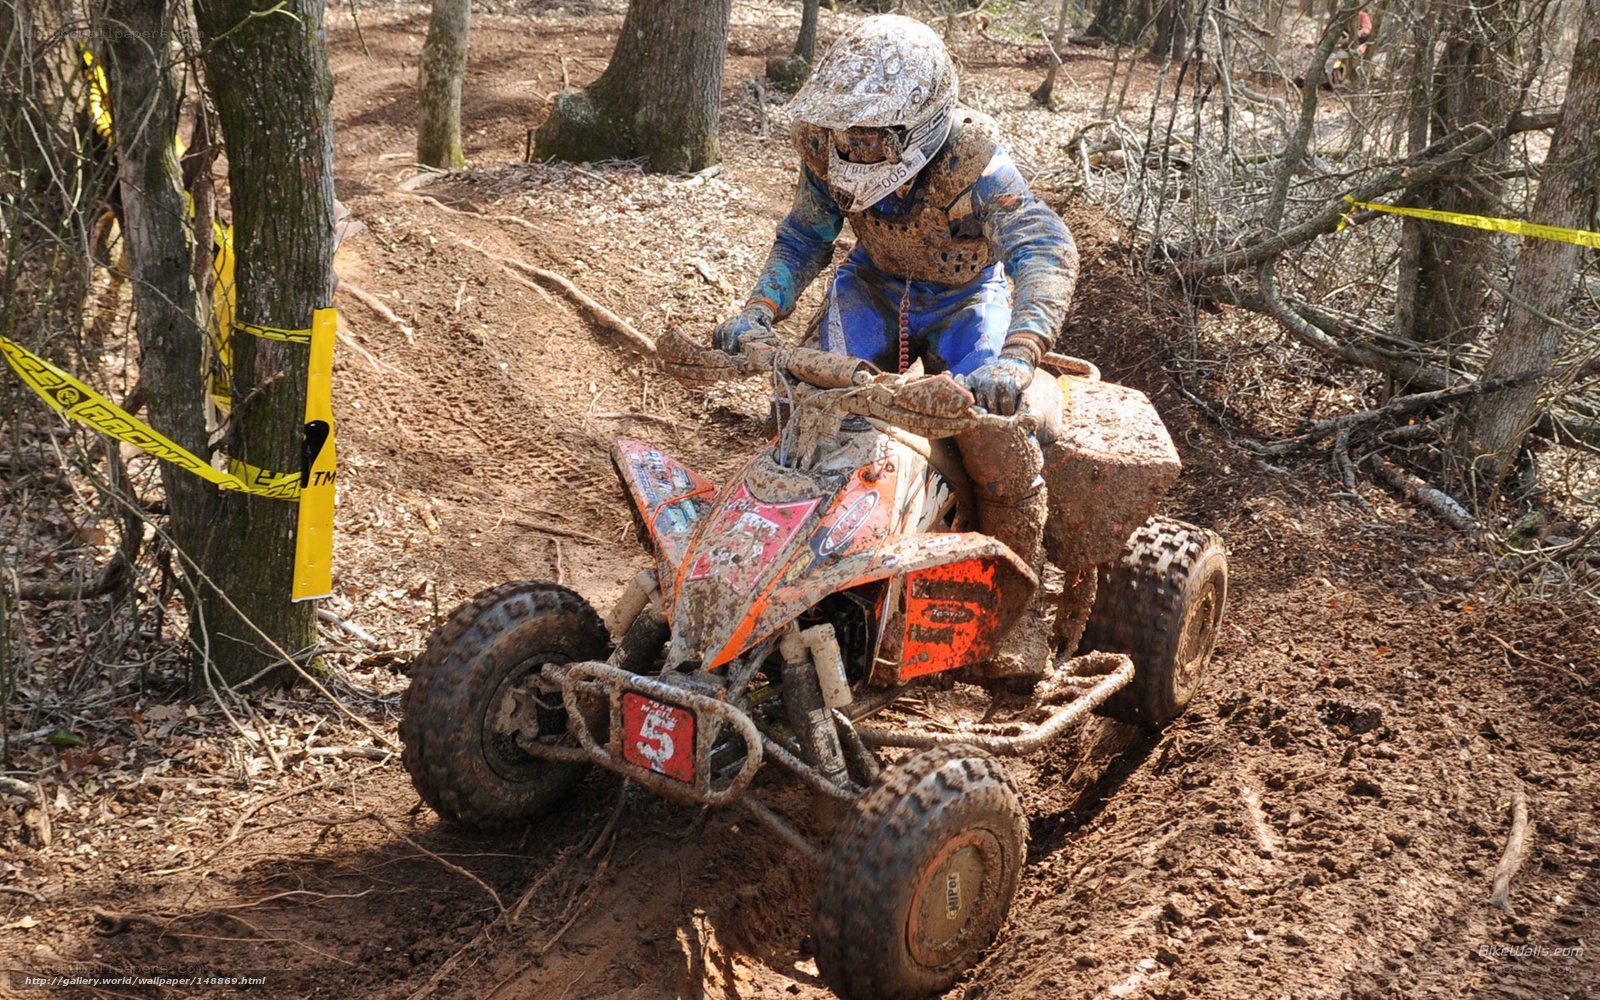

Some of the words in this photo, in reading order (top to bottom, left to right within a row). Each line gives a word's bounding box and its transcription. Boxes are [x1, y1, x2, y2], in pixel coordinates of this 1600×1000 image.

[881, 167, 907, 188] 005
[314, 471, 336, 486] TM
[636, 713, 679, 765] 5
